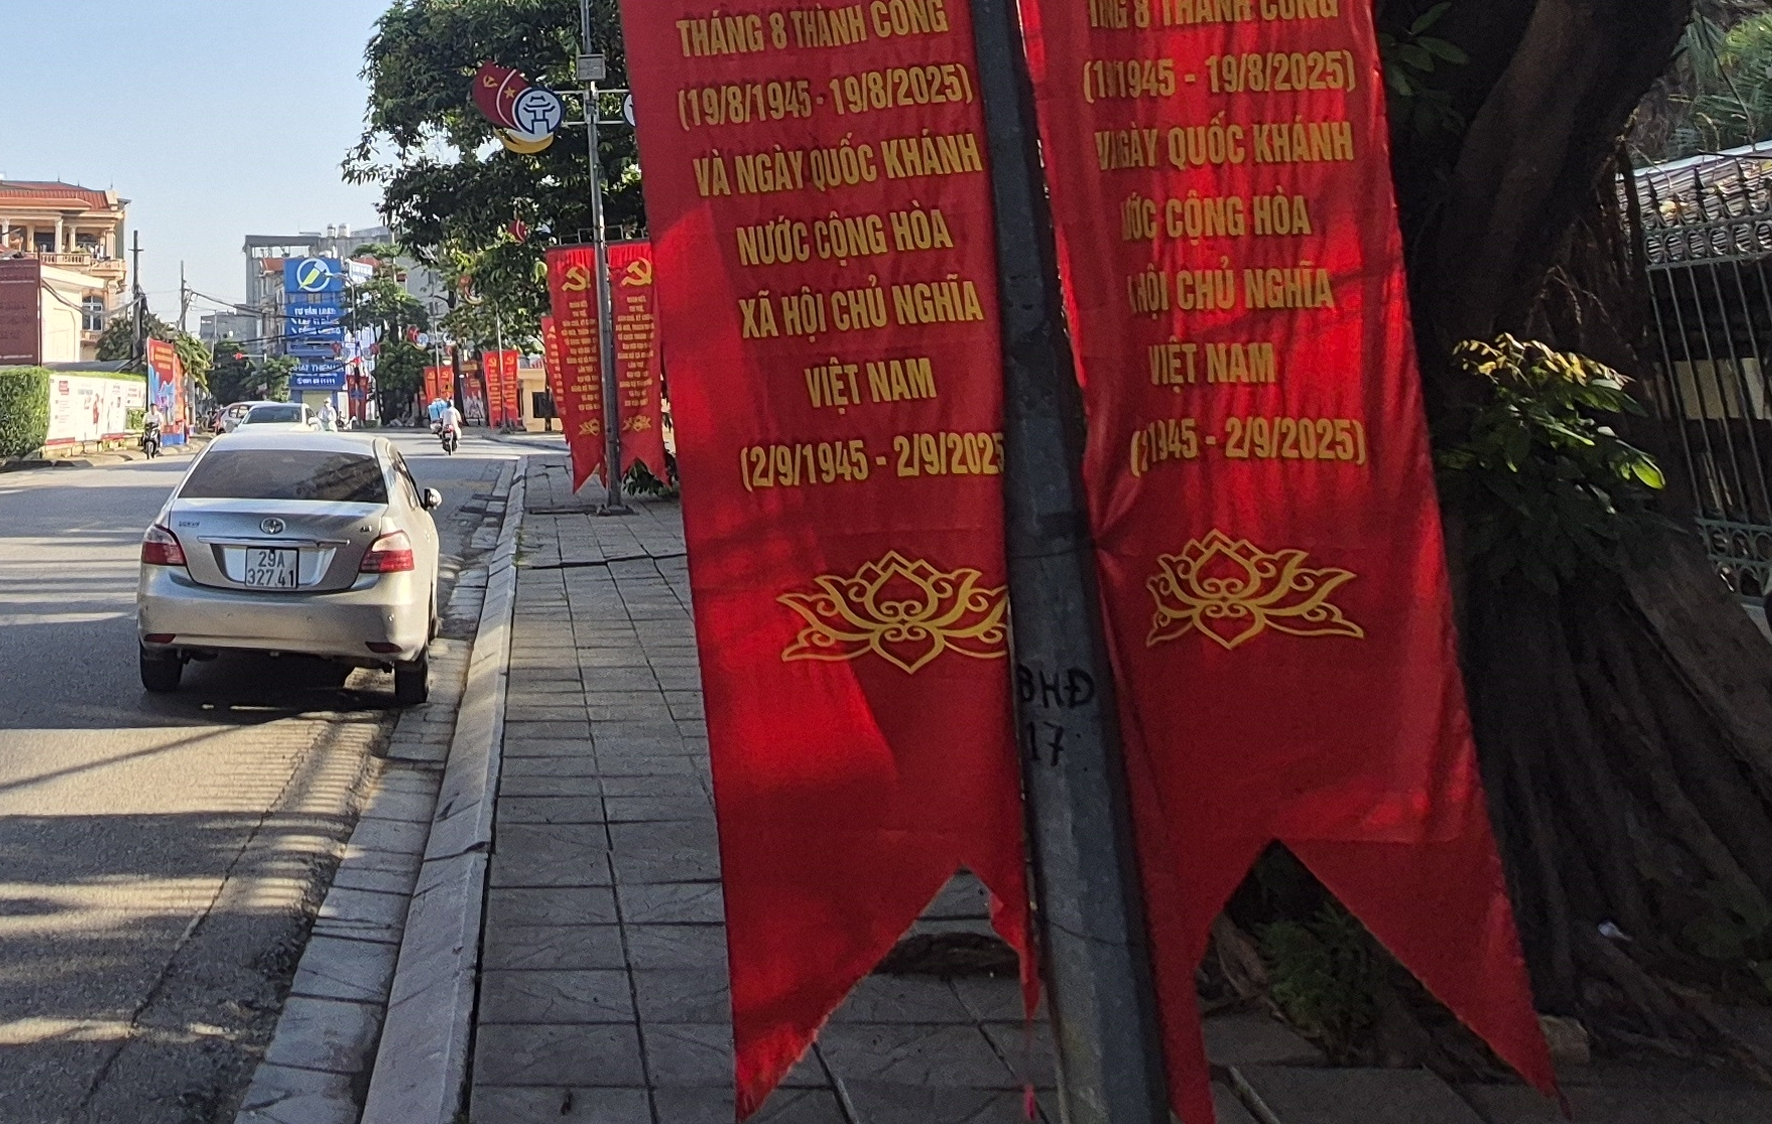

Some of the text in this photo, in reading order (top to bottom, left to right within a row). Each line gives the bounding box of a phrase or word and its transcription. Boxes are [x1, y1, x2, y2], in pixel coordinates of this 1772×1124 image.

[676, 9, 764, 57] THÁNG
[771, 12, 786, 49] 8
[790, 3, 866, 48] THÀNH
[678, 80, 812, 130] (19/8/1945
[830, 64, 973, 115] 19/8/2025)
[1205, 50, 1356, 94] 19/8/2025)
[692, 128, 983, 196] VÀ NGÀY QUỐC KHÁNH
[1168, 111, 1244, 170] QUỐC
[1253, 112, 1354, 163] KHÁNH
[736, 200, 953, 267] NƯỚC CỘNG HÒA
[1166, 190, 1245, 245] CỘNG
[1253, 186, 1312, 235] HÒA
[739, 273, 984, 342] XÃ HỘI CHỦ NGHĨA
[1176, 257, 1233, 310] CHỦ
[1243, 261, 1335, 309] NGHĨA
[804, 356, 937, 415] VIỆT NAM
[1148, 335, 1276, 394] VIỆT NAM
[740, 440, 869, 492] (2/9/1945
[894, 431, 1005, 477] 2/9/2025
[1225, 417, 1366, 465] 2/9/2025)
[247, 568, 295, 587] 327.41
[258, 551, 285, 568] 29A
[1029, 721, 1064, 767] 17
